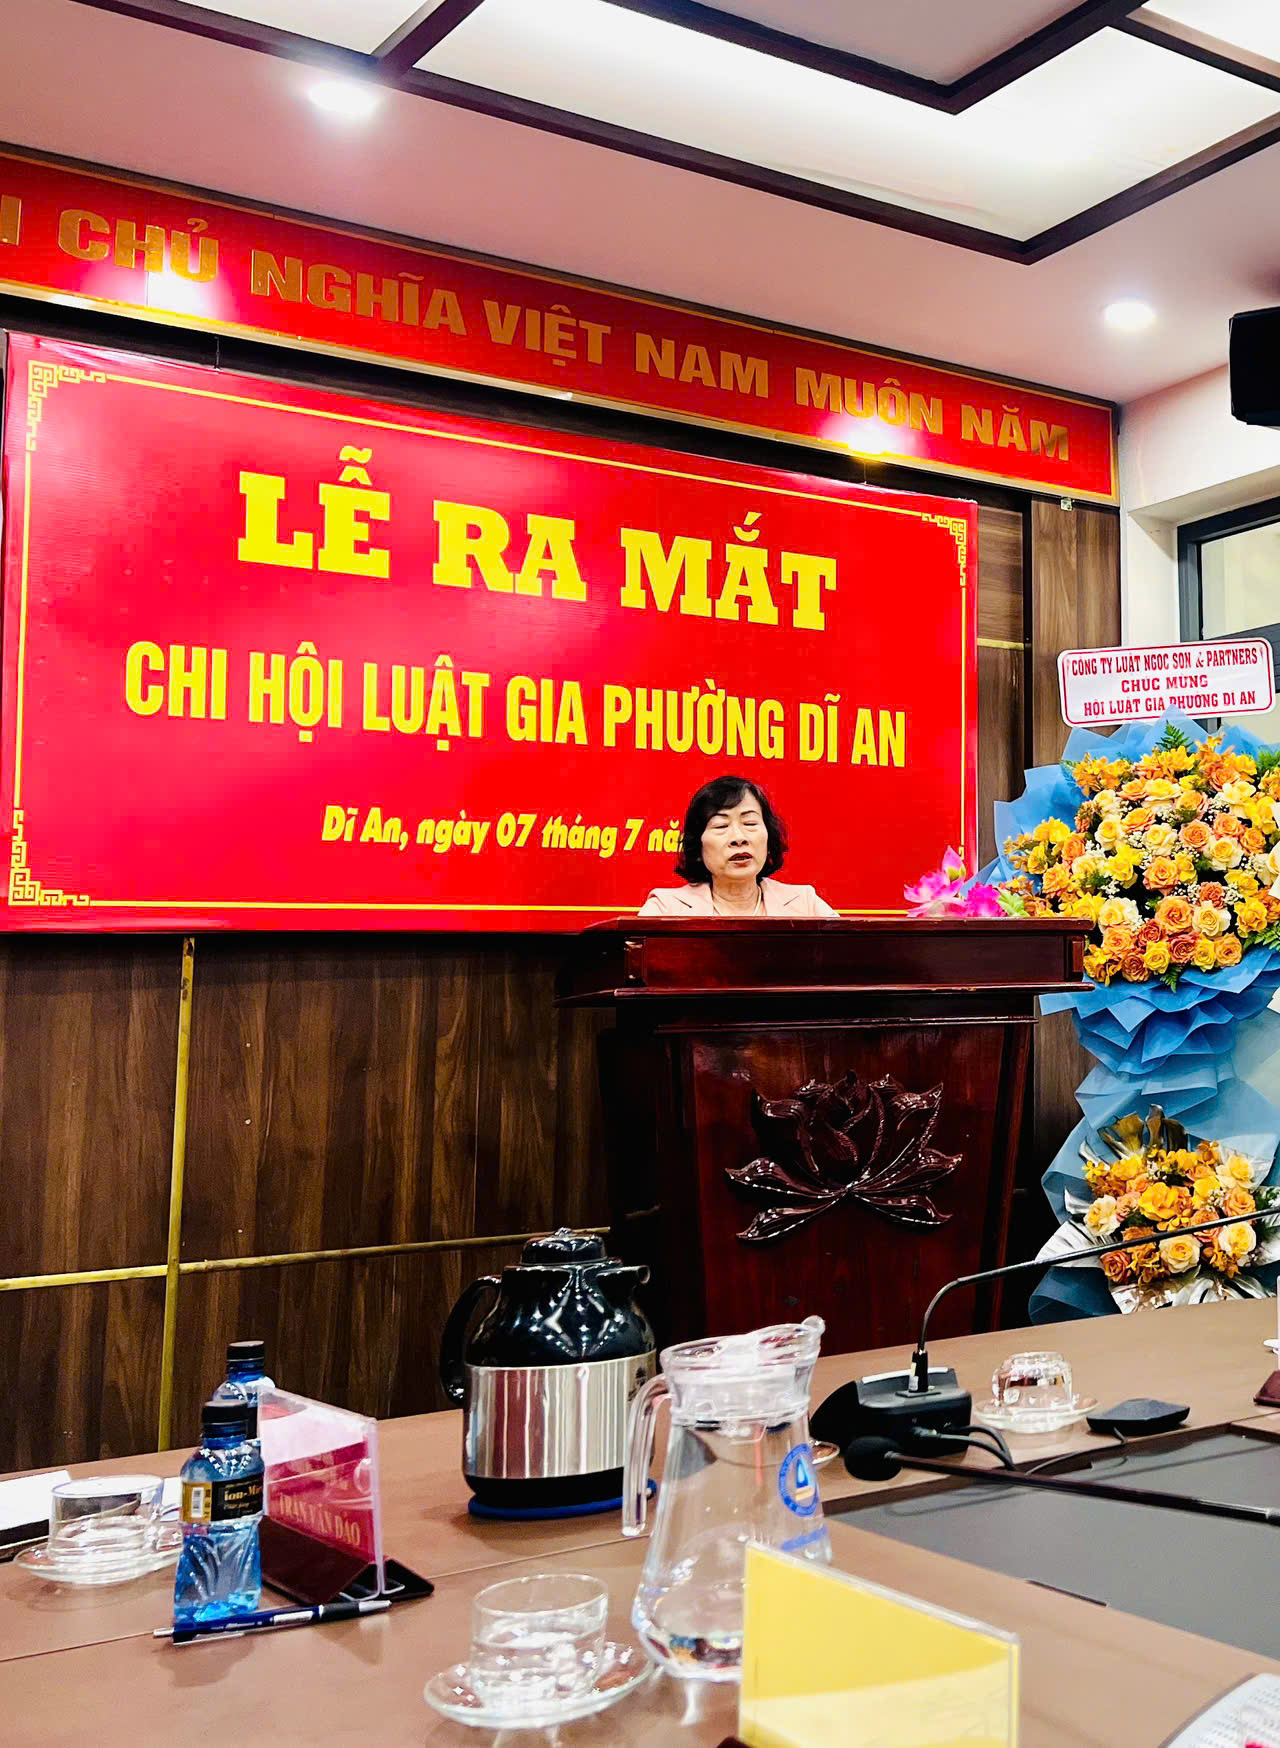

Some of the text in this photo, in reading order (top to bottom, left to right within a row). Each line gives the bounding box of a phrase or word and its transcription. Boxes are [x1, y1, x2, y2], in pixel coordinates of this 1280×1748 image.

[57, 208, 219, 283] CHỦ
[250, 248, 468, 337] NGHĨA
[482, 300, 612, 367] VIỆT
[634, 332, 769, 399] NAM
[795, 366, 943, 435] MUÔN
[961, 404, 1070, 462] NĂM
[238, 445, 837, 631] LỄ RA MẮT
[125, 641, 906, 768] CHI HỘI LUẬT GIA PHƯỜNG DĨ AN
[1100, 657, 1112, 674] TY
[1196, 652, 1204, 668] &
[1206, 647, 1258, 667] PARTNERS
[1145, 696, 1165, 712] GIA
[1240, 690, 1256, 705] AN
[321, 805, 685, 858] Dĩ An, ngày 07 tháng 7 nă
